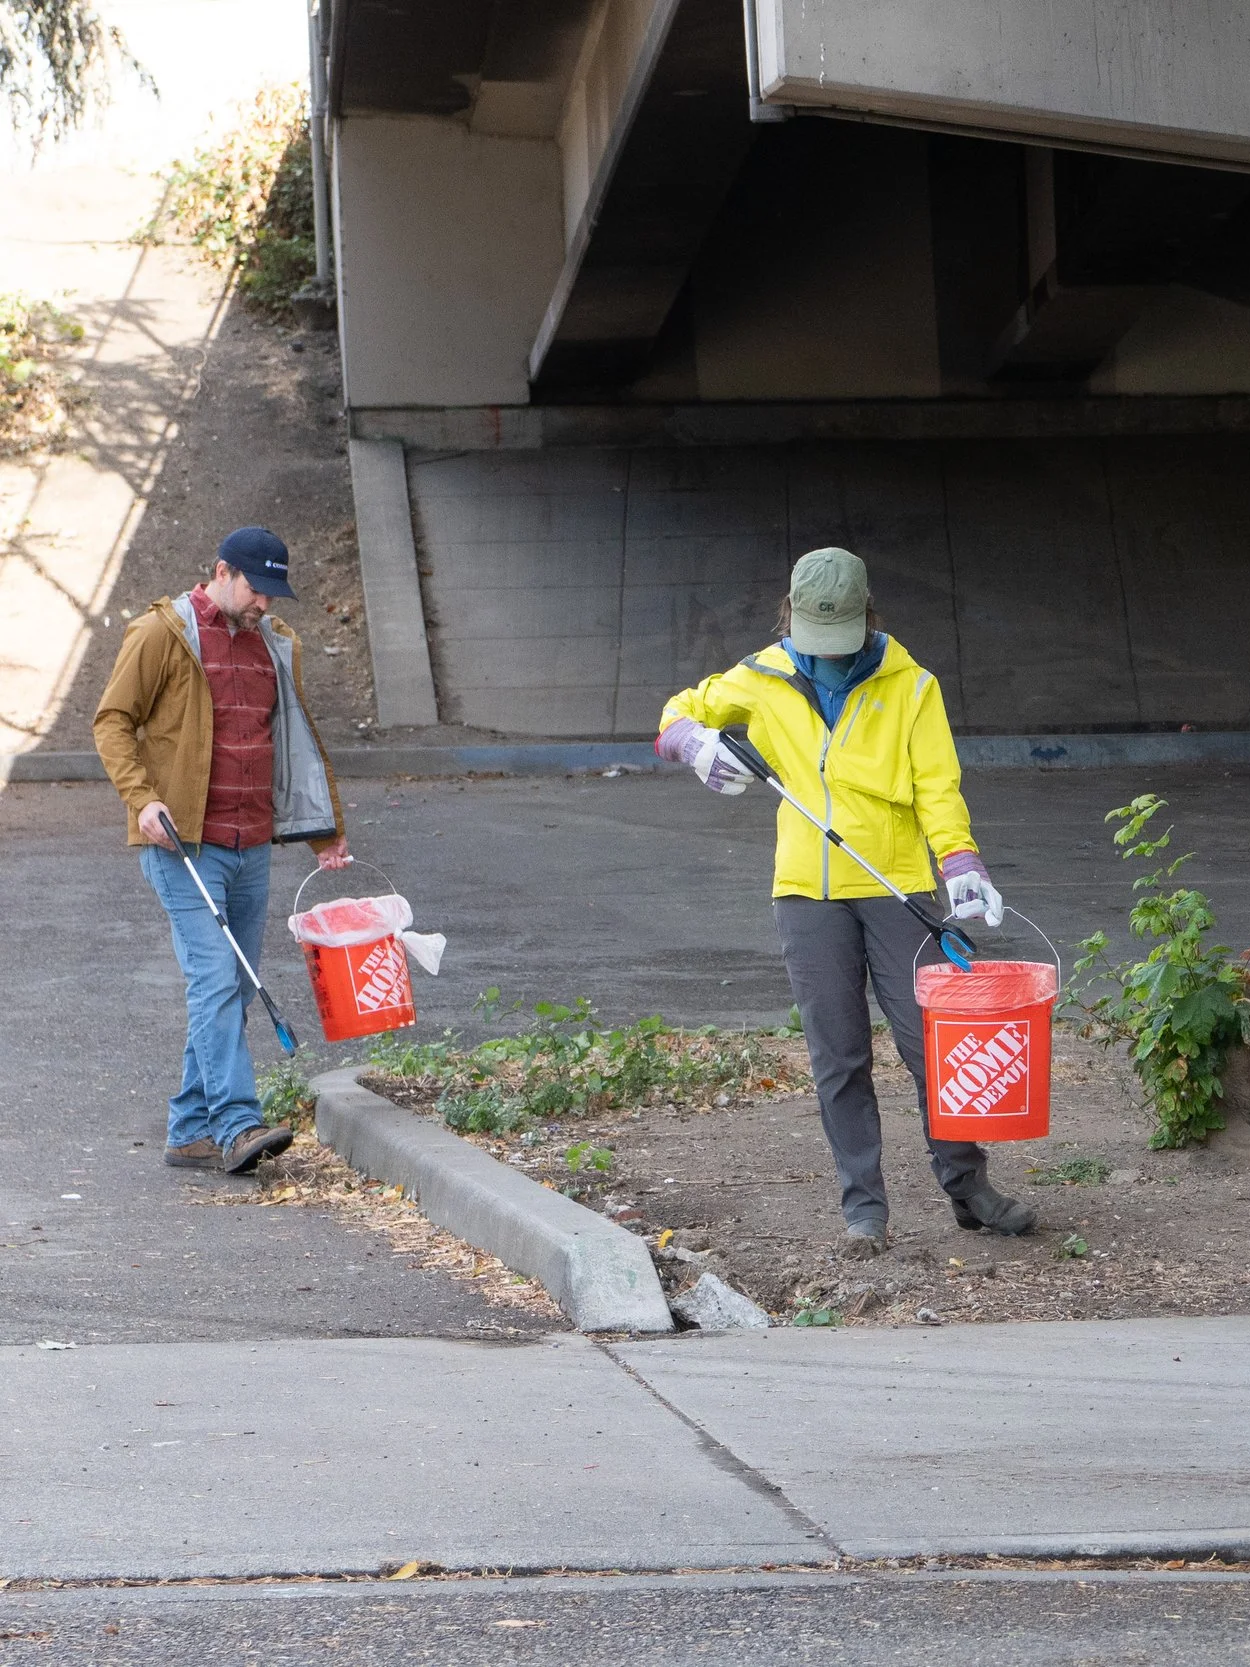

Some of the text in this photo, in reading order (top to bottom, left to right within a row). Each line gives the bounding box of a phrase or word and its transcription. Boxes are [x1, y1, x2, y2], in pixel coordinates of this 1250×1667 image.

[358, 944, 387, 976] THE
[940, 1022, 1029, 1115] HOME
[944, 1032, 983, 1069] THE
[970, 1056, 1028, 1115] DEPOT
